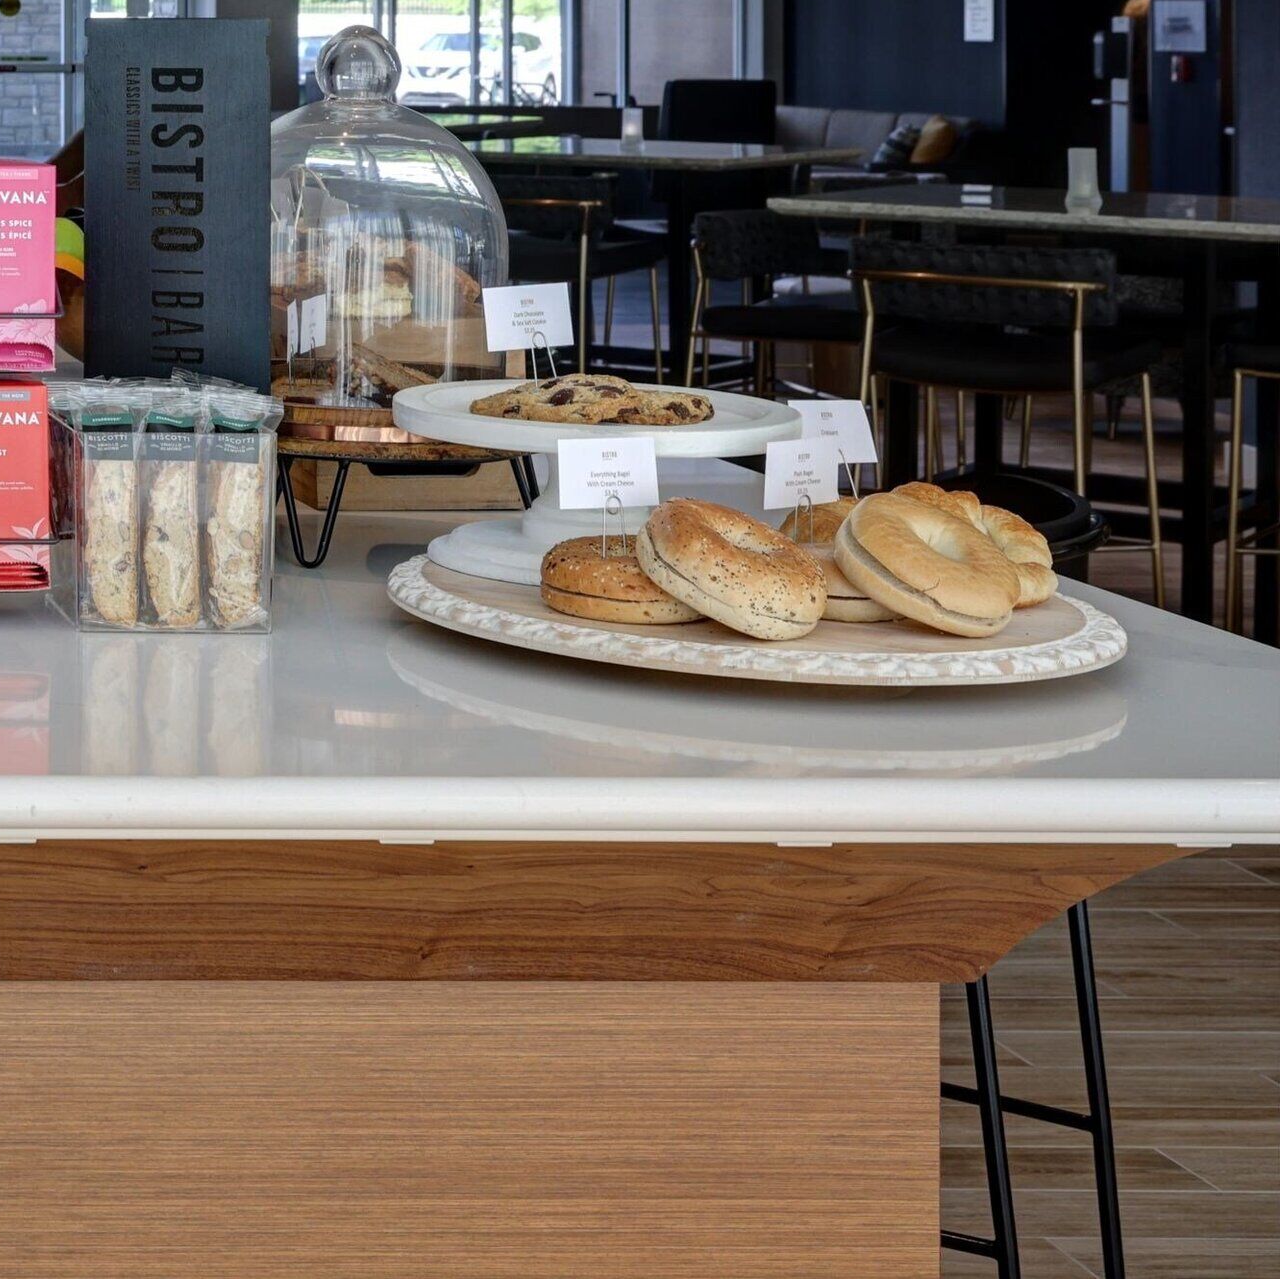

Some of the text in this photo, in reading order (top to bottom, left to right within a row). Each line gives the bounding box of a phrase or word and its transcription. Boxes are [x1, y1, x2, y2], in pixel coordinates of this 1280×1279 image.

[151, 68, 204, 252] BISTRO
[8, 220, 33, 228] SPICE
[8, 230, 32, 240] ÉPICÉ
[151, 290, 204, 365] BAR
[88, 434, 128, 442] BISCOTTI
[152, 433, 190, 442] BISCOTTI
